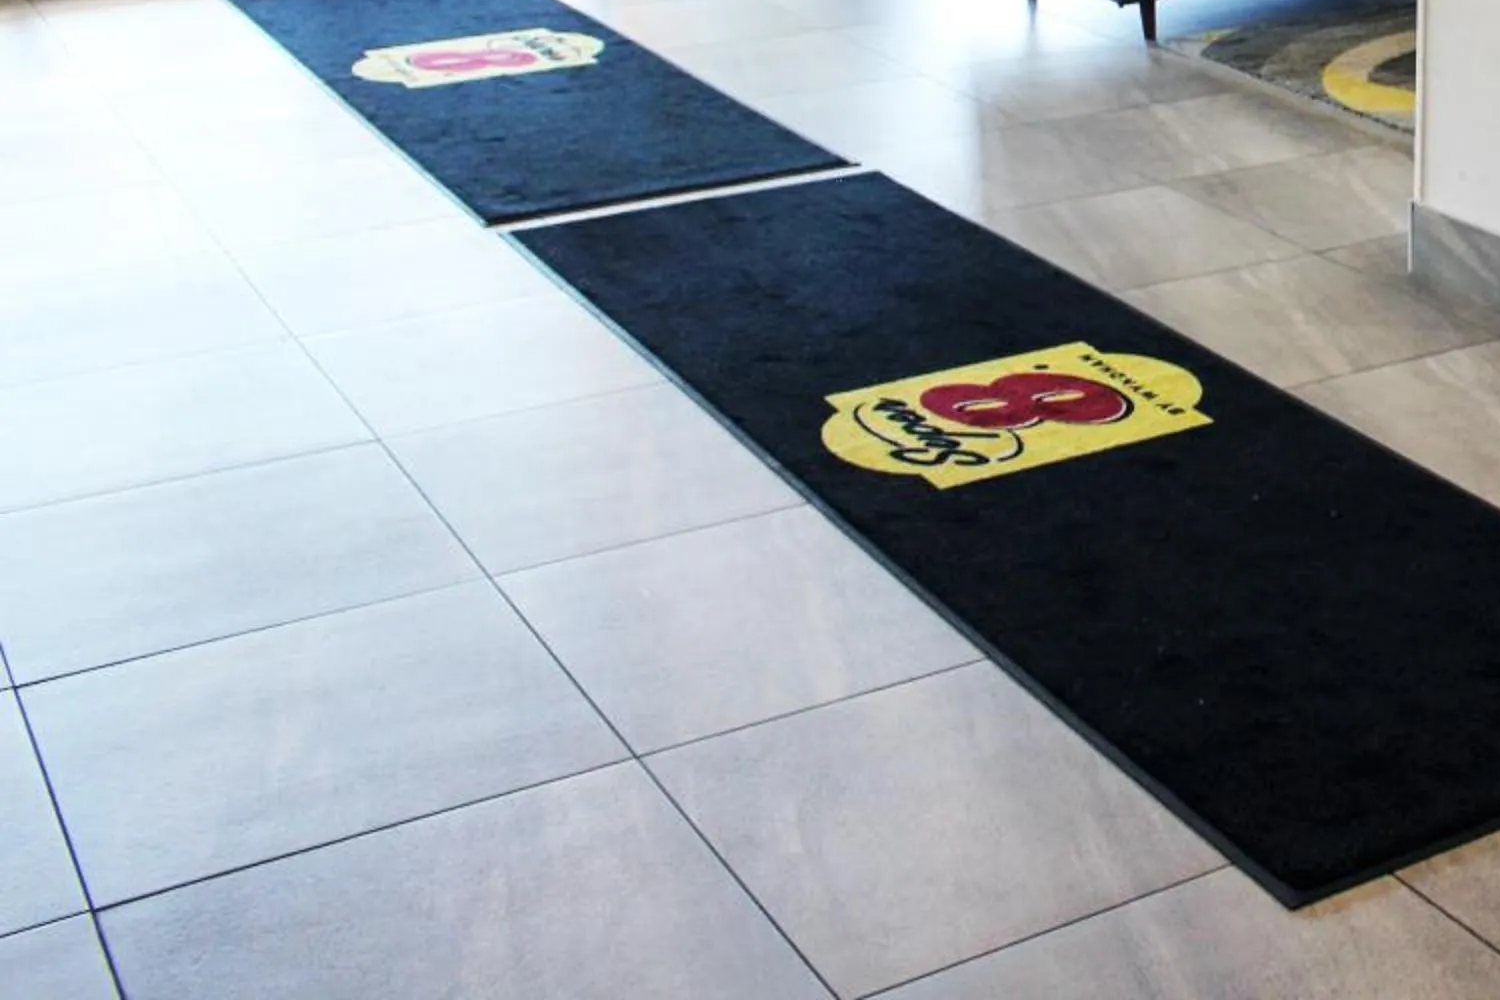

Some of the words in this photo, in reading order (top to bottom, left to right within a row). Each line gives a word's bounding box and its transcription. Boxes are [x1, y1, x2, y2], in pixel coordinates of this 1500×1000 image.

[920, 372, 1134, 430] 8
[1079, 353, 1160, 401] WYNDHAM
[872, 397, 1001, 467] Super
[1155, 402, 1186, 416] BY
